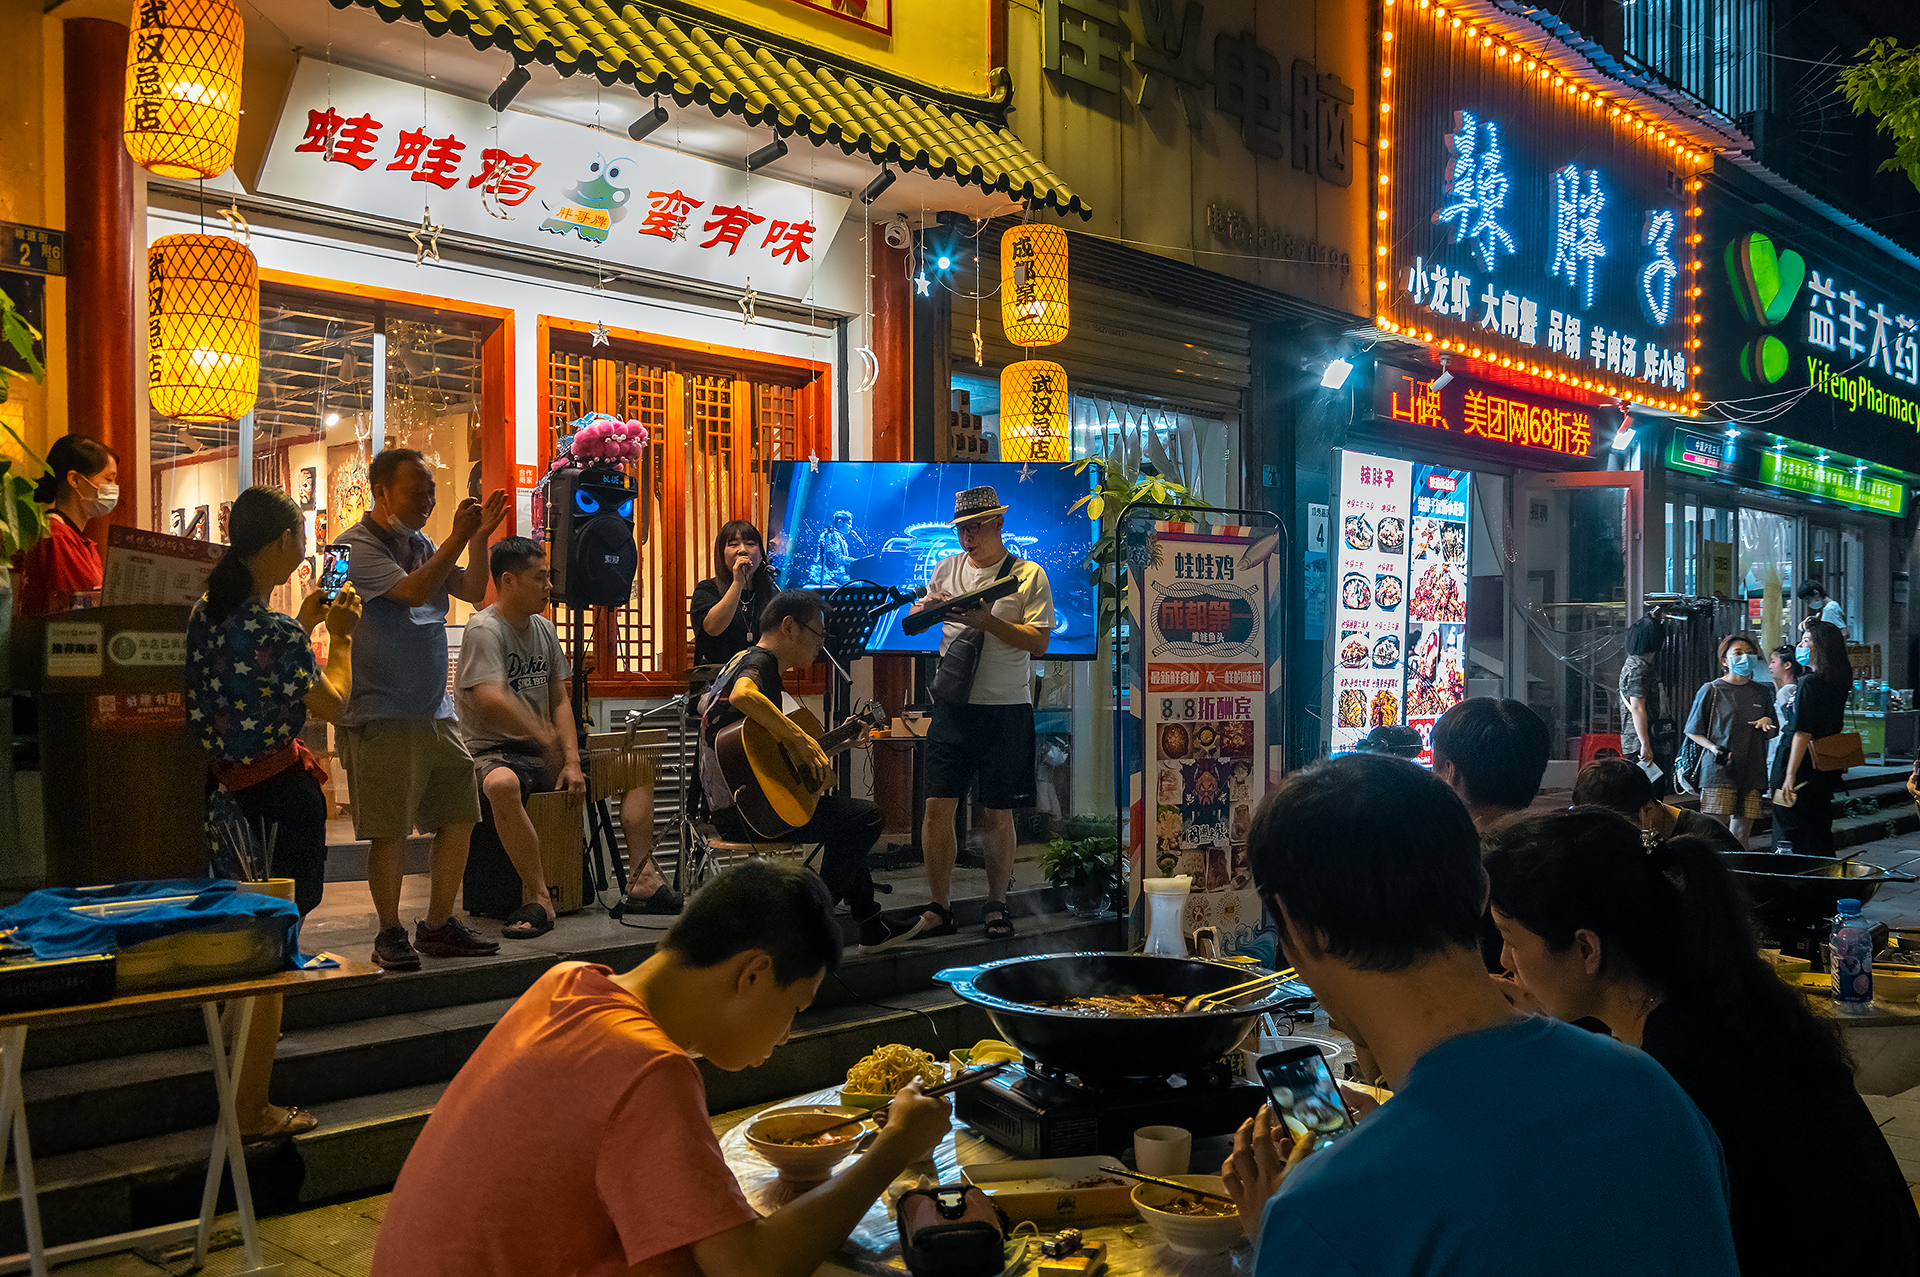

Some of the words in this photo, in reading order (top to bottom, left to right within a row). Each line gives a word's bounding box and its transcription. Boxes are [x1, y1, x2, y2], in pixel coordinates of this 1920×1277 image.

[134, 0, 167, 131] 武汉总店
[295, 107, 542, 206] 蛙蛙鸡
[638, 189, 816, 265] 蛮有味
[556, 206, 607, 227] 胖哥牌
[19, 243, 31, 266] 2
[1407, 255, 1471, 322] 小龙虾
[1548, 309, 1581, 361] 吊锅
[1590, 325, 1637, 377] 羊肉汤
[1644, 342, 1686, 392] 炸小串
[1807, 270, 1919, 386] 益丰大药
[1029, 374, 1052, 460] 武汉总店
[1463, 387, 1592, 457] 美团网68折券
[518, 468, 533, 477] 合作
[518, 476, 533, 485] 商家
[1316, 522, 1325, 548] 4
[1174, 552, 1234, 581] 蛙蛙鸡
[1161, 600, 1252, 631] 成都第一
[1150, 670, 1200, 685] 最新鲜食材
[1205, 670, 1262, 685] 不一样的味道
